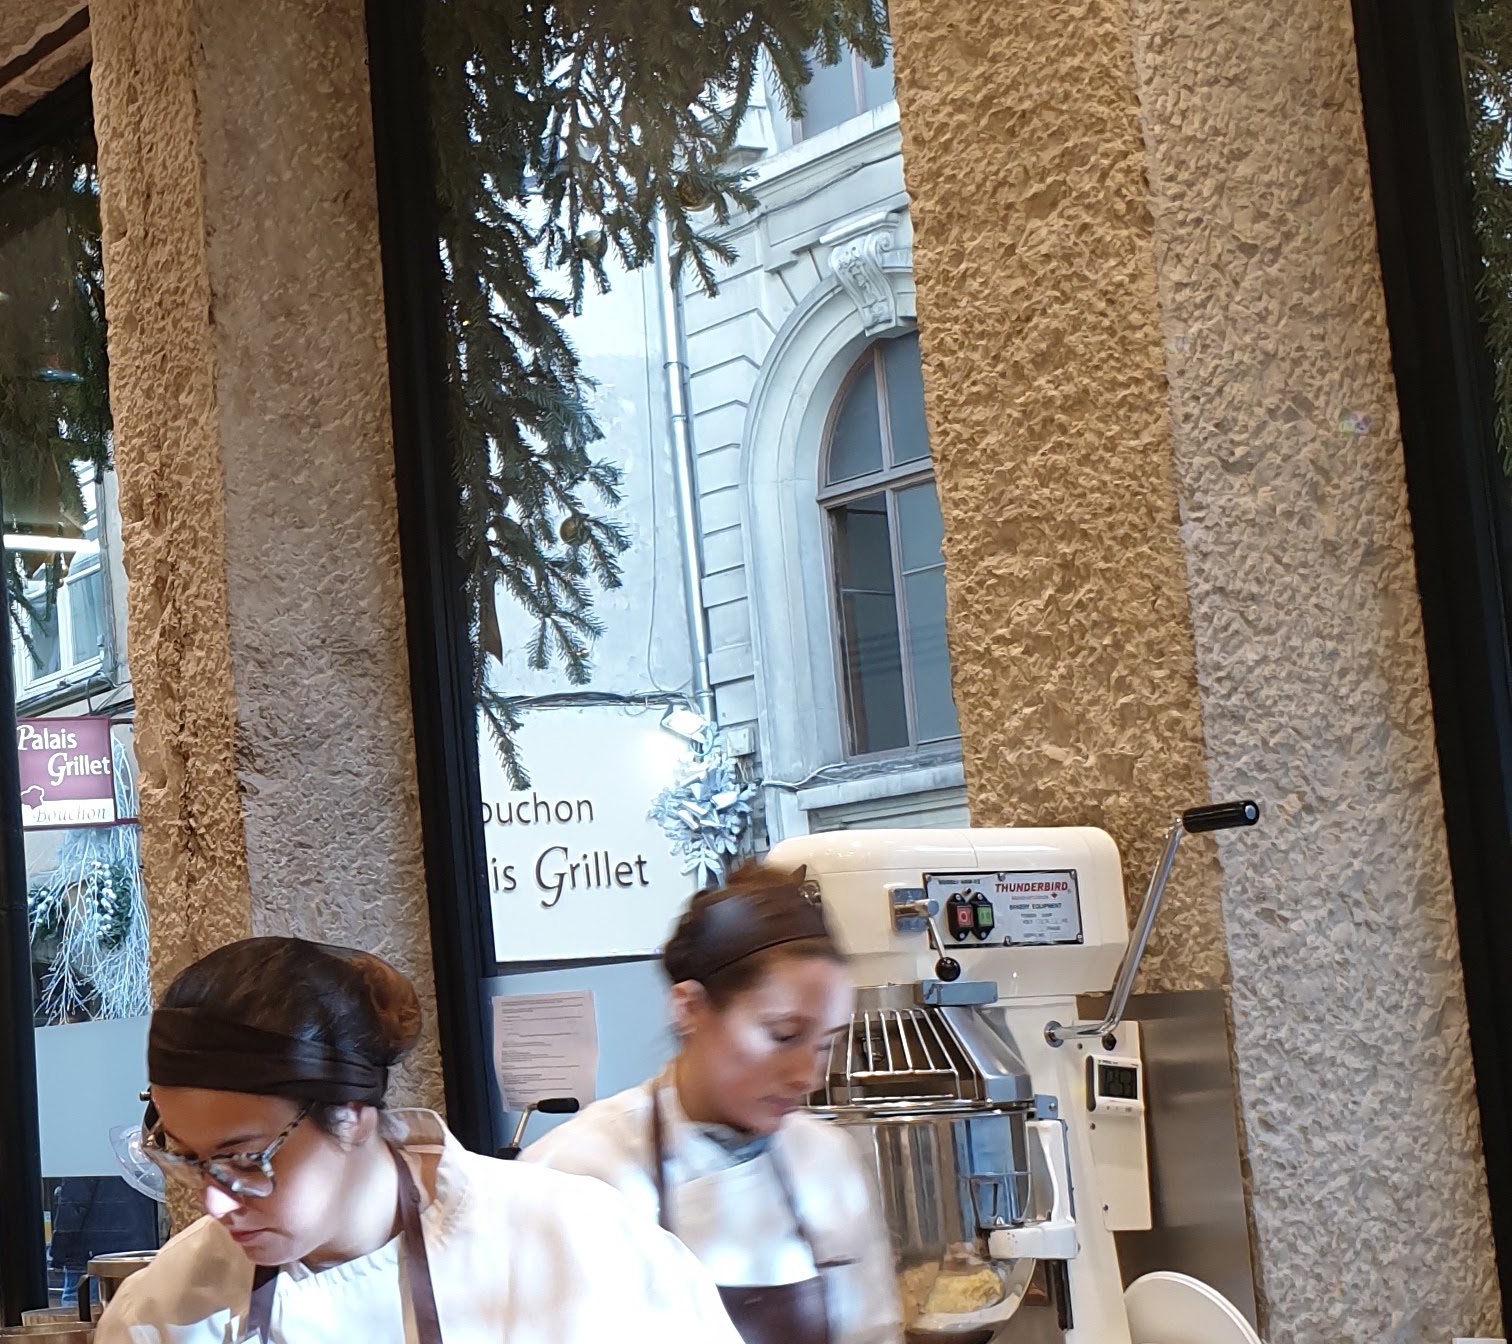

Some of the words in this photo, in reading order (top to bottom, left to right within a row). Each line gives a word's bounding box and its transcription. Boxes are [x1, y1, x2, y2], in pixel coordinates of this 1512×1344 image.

[16, 724, 78, 750] Palais
[47, 752, 111, 786] Grillet
[34, 804, 106, 823] Bouchon
[535, 845, 650, 908] Grillet
[995, 881, 1068, 893] THUNDERBIRD
